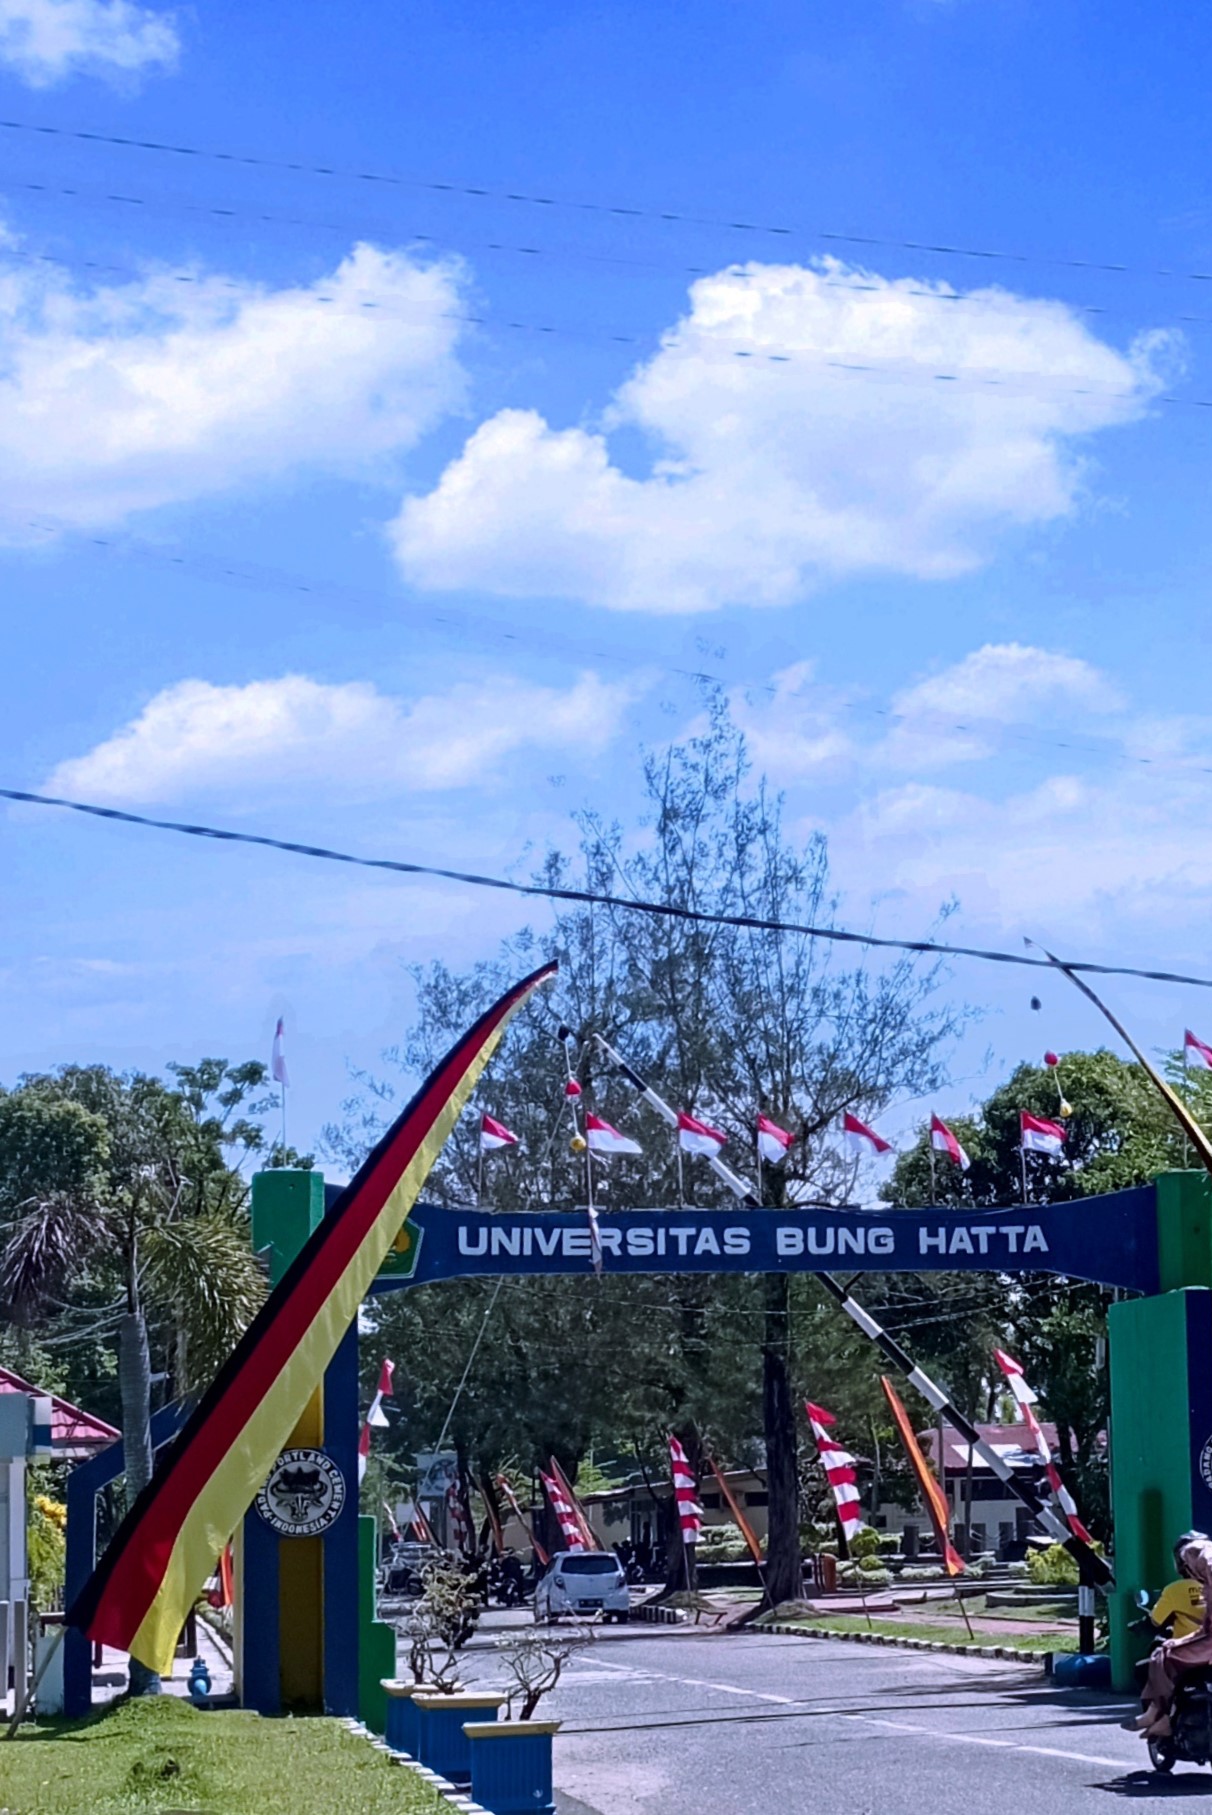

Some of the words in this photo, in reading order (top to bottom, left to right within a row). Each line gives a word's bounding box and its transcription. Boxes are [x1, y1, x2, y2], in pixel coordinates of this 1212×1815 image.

[458, 1226, 750, 1256] UNIVERSITAS
[776, 1227, 895, 1255] BUNG
[919, 1225, 1049, 1254] HATTA
[328, 1469, 343, 1518] CEMENT
[270, 1517, 328, 1534] INDONESIA
